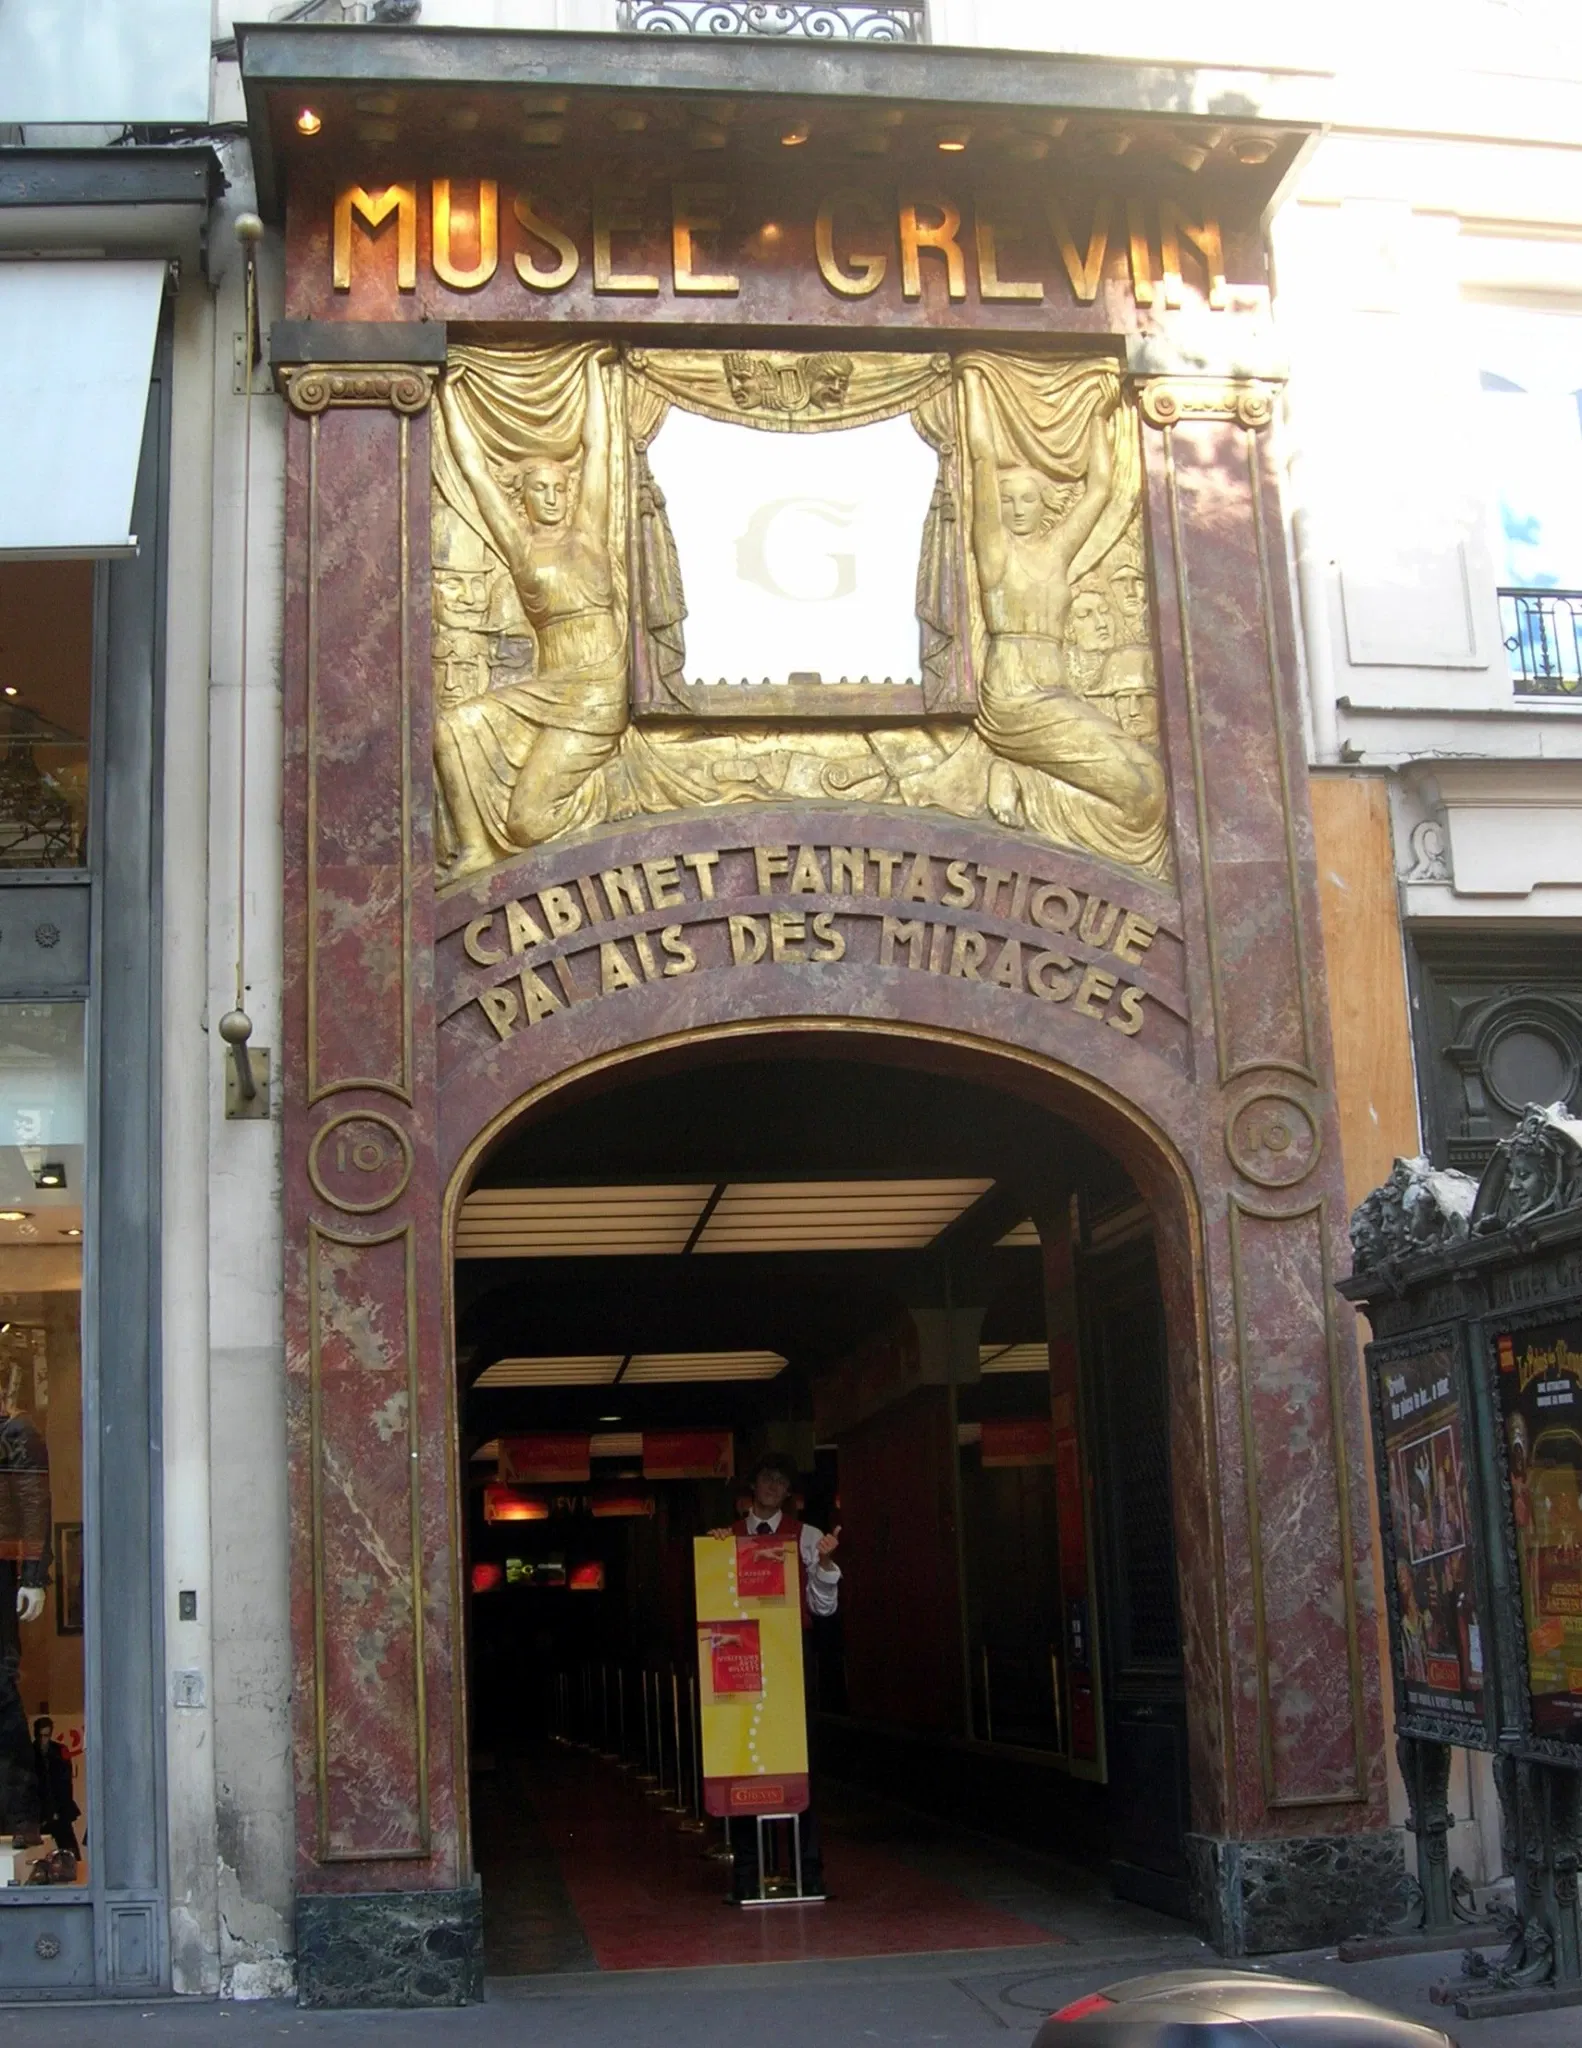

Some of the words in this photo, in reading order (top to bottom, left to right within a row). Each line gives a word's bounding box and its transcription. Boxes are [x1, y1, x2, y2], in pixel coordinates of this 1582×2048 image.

[463, 850, 720, 966] CABINET
[754, 845, 1157, 964] FANTASTIQUE
[477, 924, 698, 1041] PALAIS
[728, 911, 846, 966] DES
[879, 914, 1146, 1036] MIRAGES
